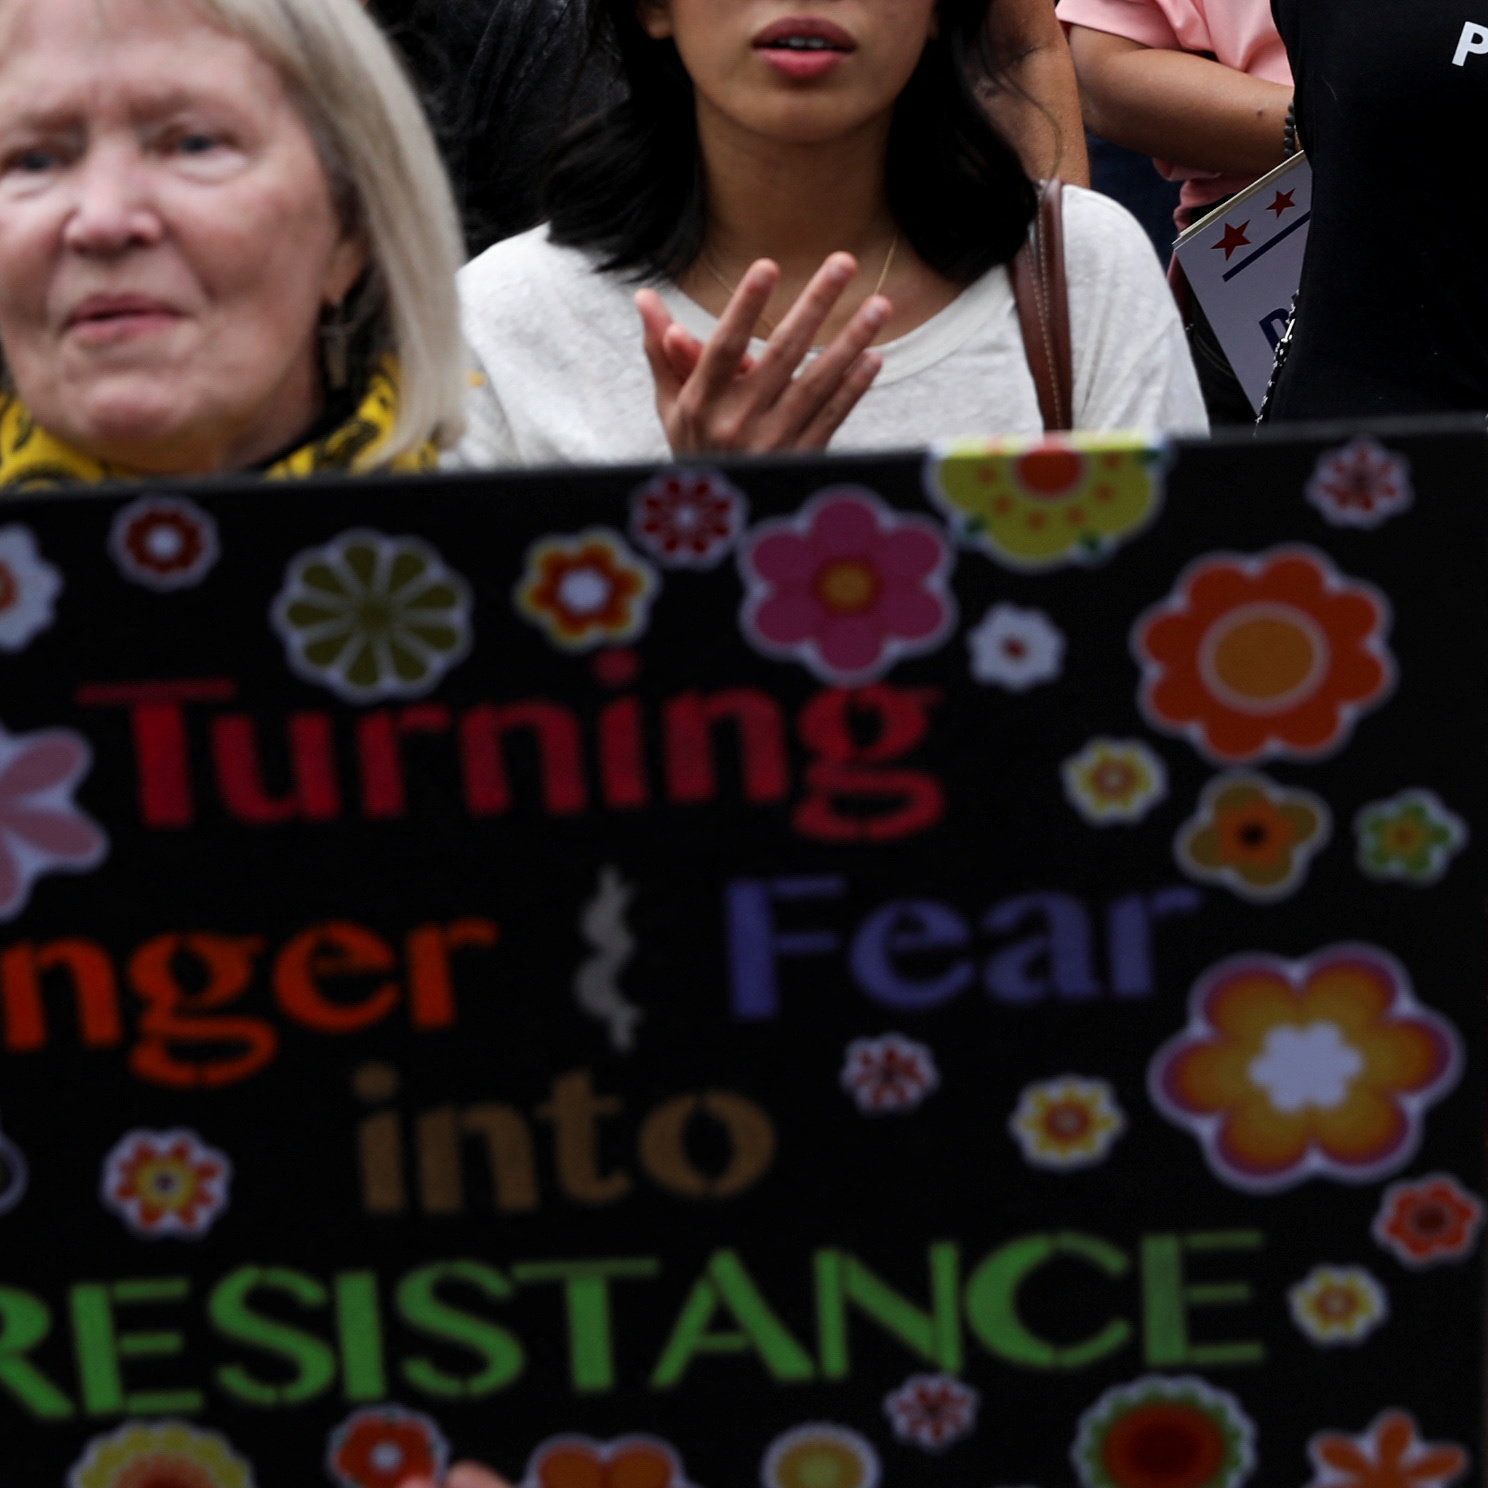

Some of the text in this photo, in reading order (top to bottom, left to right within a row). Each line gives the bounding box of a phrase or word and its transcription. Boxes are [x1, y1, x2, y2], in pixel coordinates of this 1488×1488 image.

[76, 650, 947, 840] Turning
[724, 872, 1204, 1019] Fear
[354, 1062, 777, 1215] into
